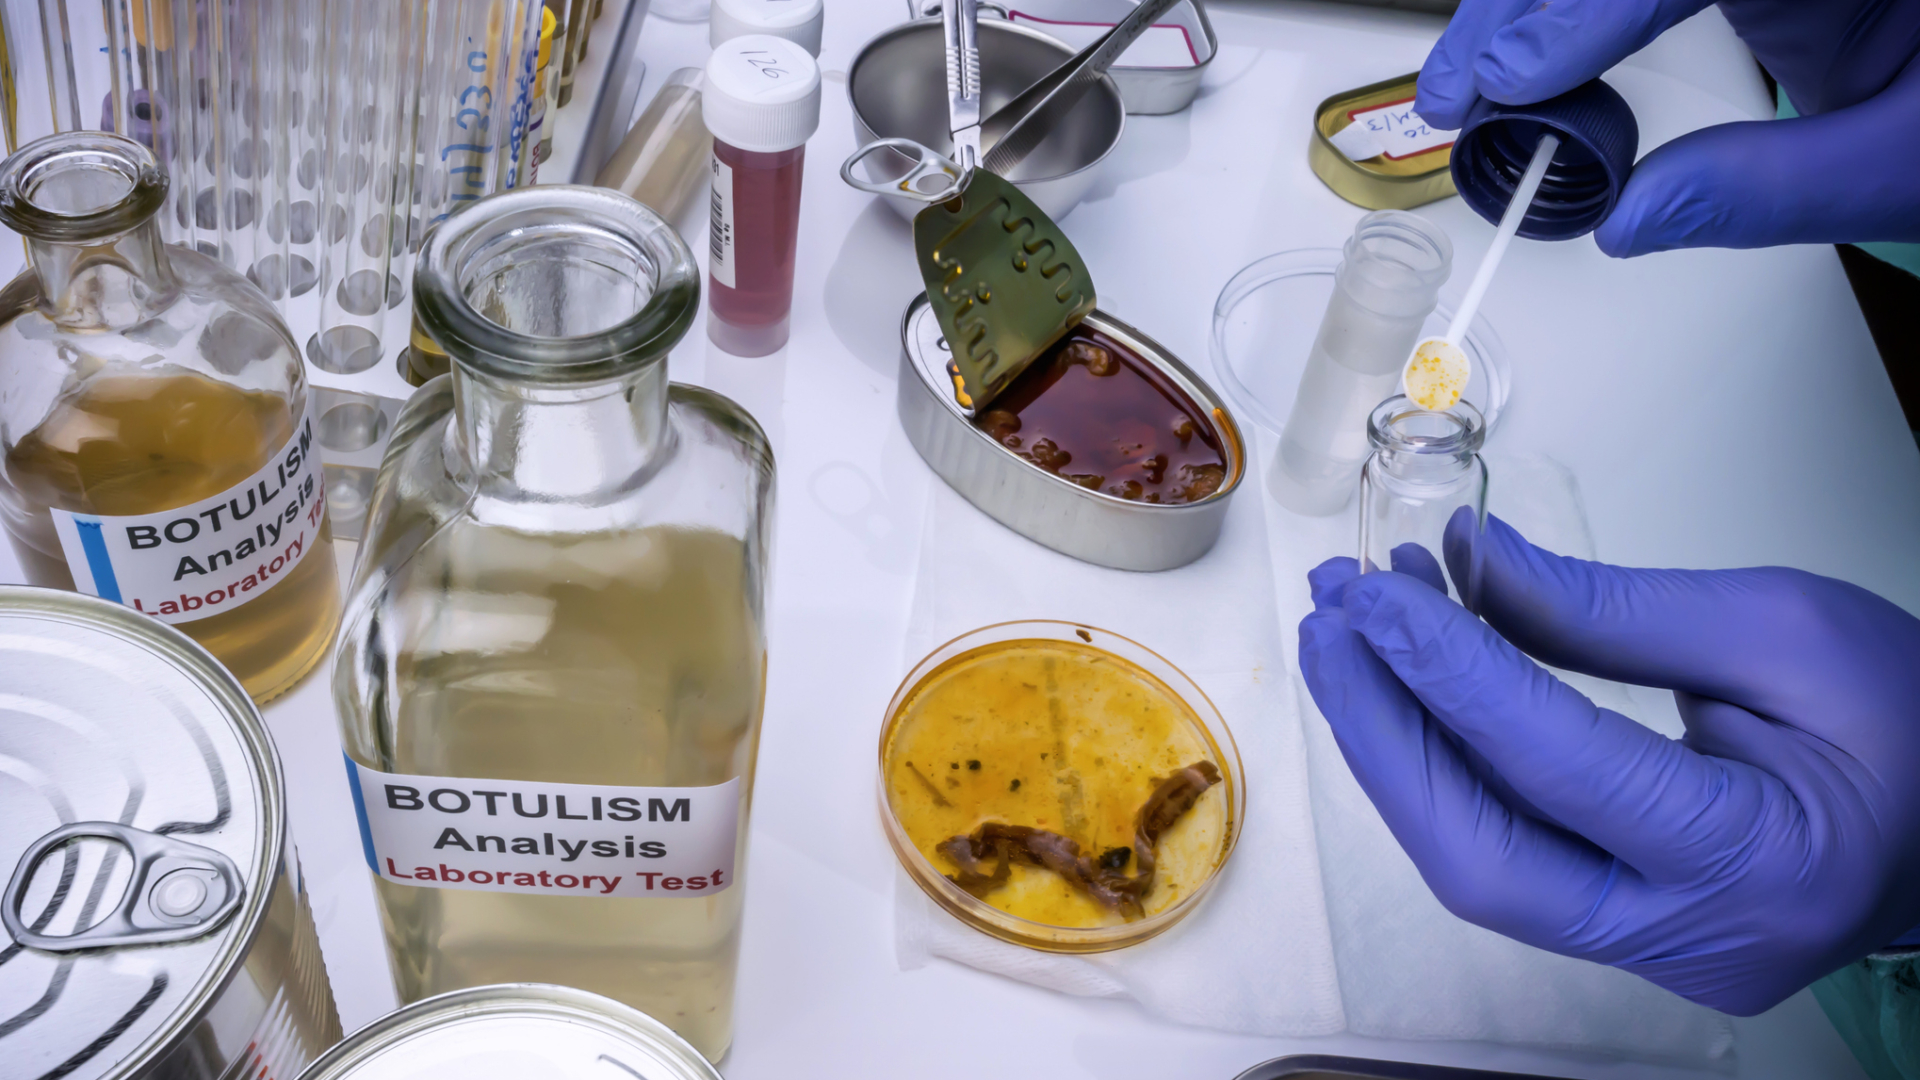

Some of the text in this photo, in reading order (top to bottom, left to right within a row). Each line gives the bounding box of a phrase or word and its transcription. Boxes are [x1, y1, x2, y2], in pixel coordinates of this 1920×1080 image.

[739, 50, 789, 79] 126
[126, 416, 312, 550] BOTULISM
[173, 473, 314, 582] Analysis
[133, 531, 304, 616] Laboratory
[384, 783, 691, 822] BOTULISM
[433, 827, 668, 862] Analysis
[386, 857, 724, 894] Laboratory Test
